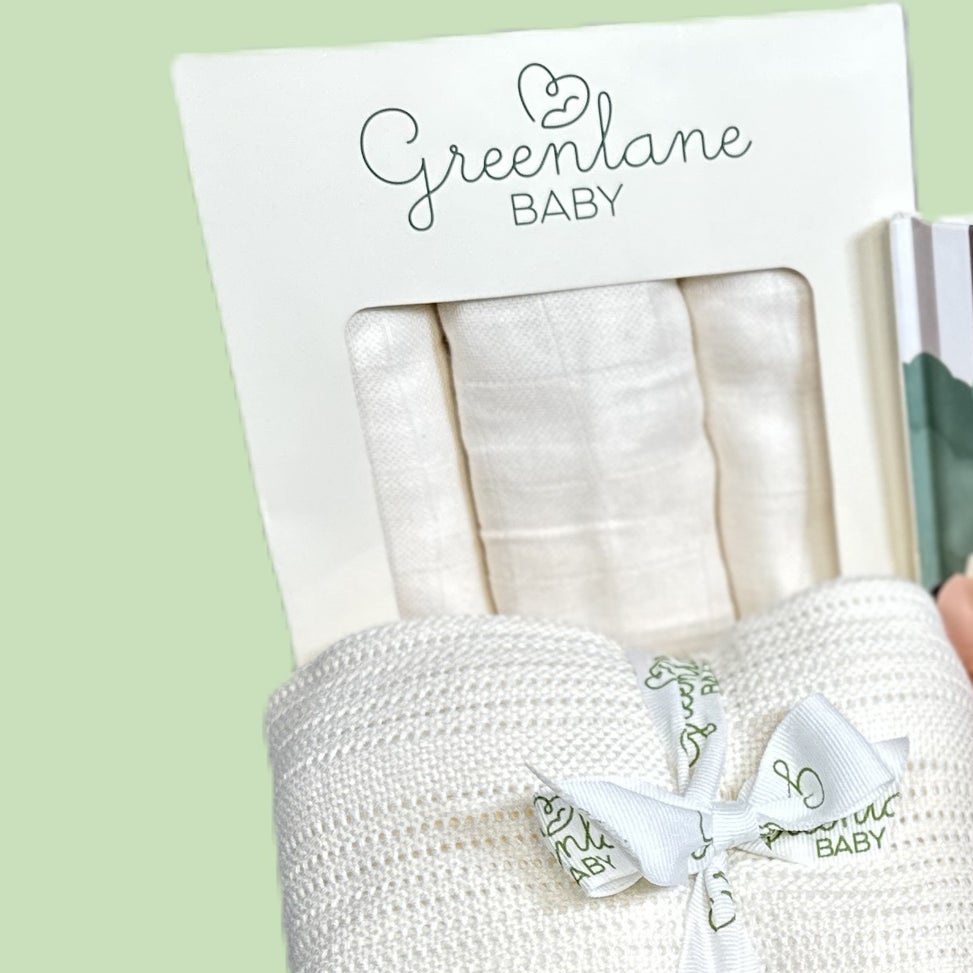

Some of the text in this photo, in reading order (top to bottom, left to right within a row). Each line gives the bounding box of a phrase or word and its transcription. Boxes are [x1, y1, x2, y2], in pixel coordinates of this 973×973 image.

[360, 91, 753, 231] Greenlane
[510, 183, 624, 227] BABY
[816, 827, 886, 858] BABY
[570, 854, 616, 886] ABY
